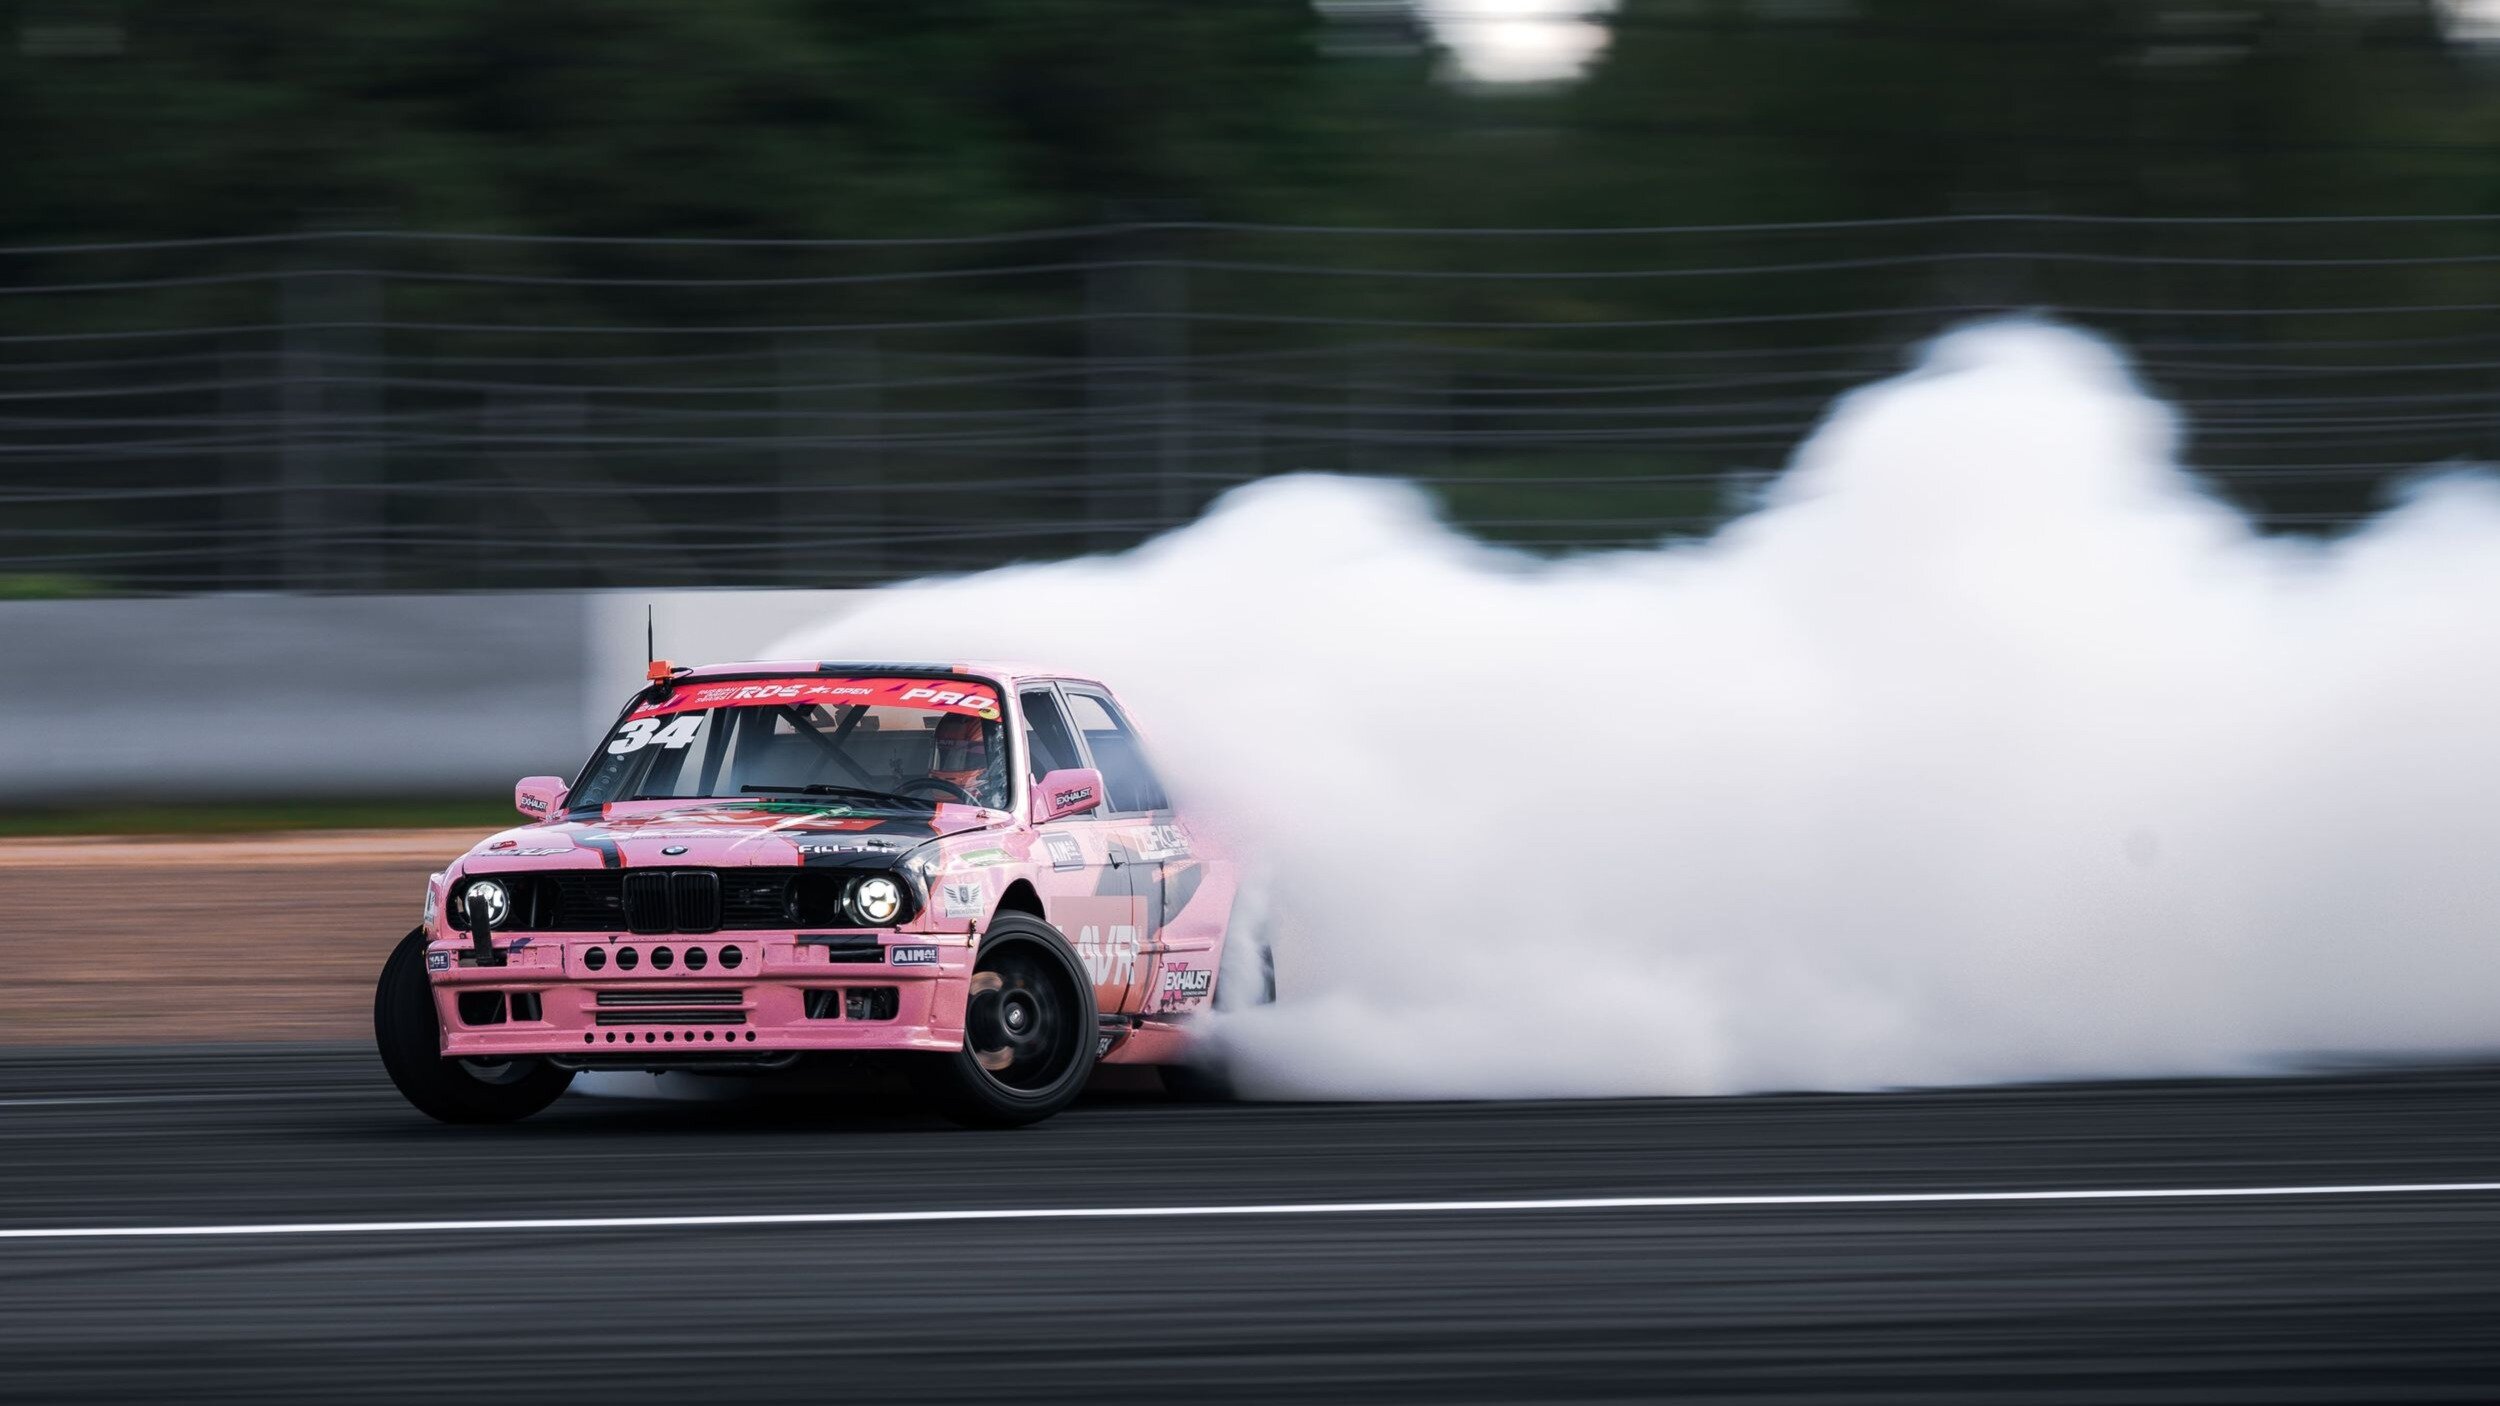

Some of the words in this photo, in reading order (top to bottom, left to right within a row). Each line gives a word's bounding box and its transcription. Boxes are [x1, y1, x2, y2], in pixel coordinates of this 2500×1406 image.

[734, 685, 807, 699] RDS
[831, 687, 873, 695] OPEN
[900, 688, 996, 709] PRO
[609, 716, 704, 754] 34
[521, 798, 548, 810] EXHAUST
[1056, 788, 1091, 805] EXHAUST
[894, 949, 936, 961] AIMOL
[1165, 971, 1211, 991] EXHAUST
